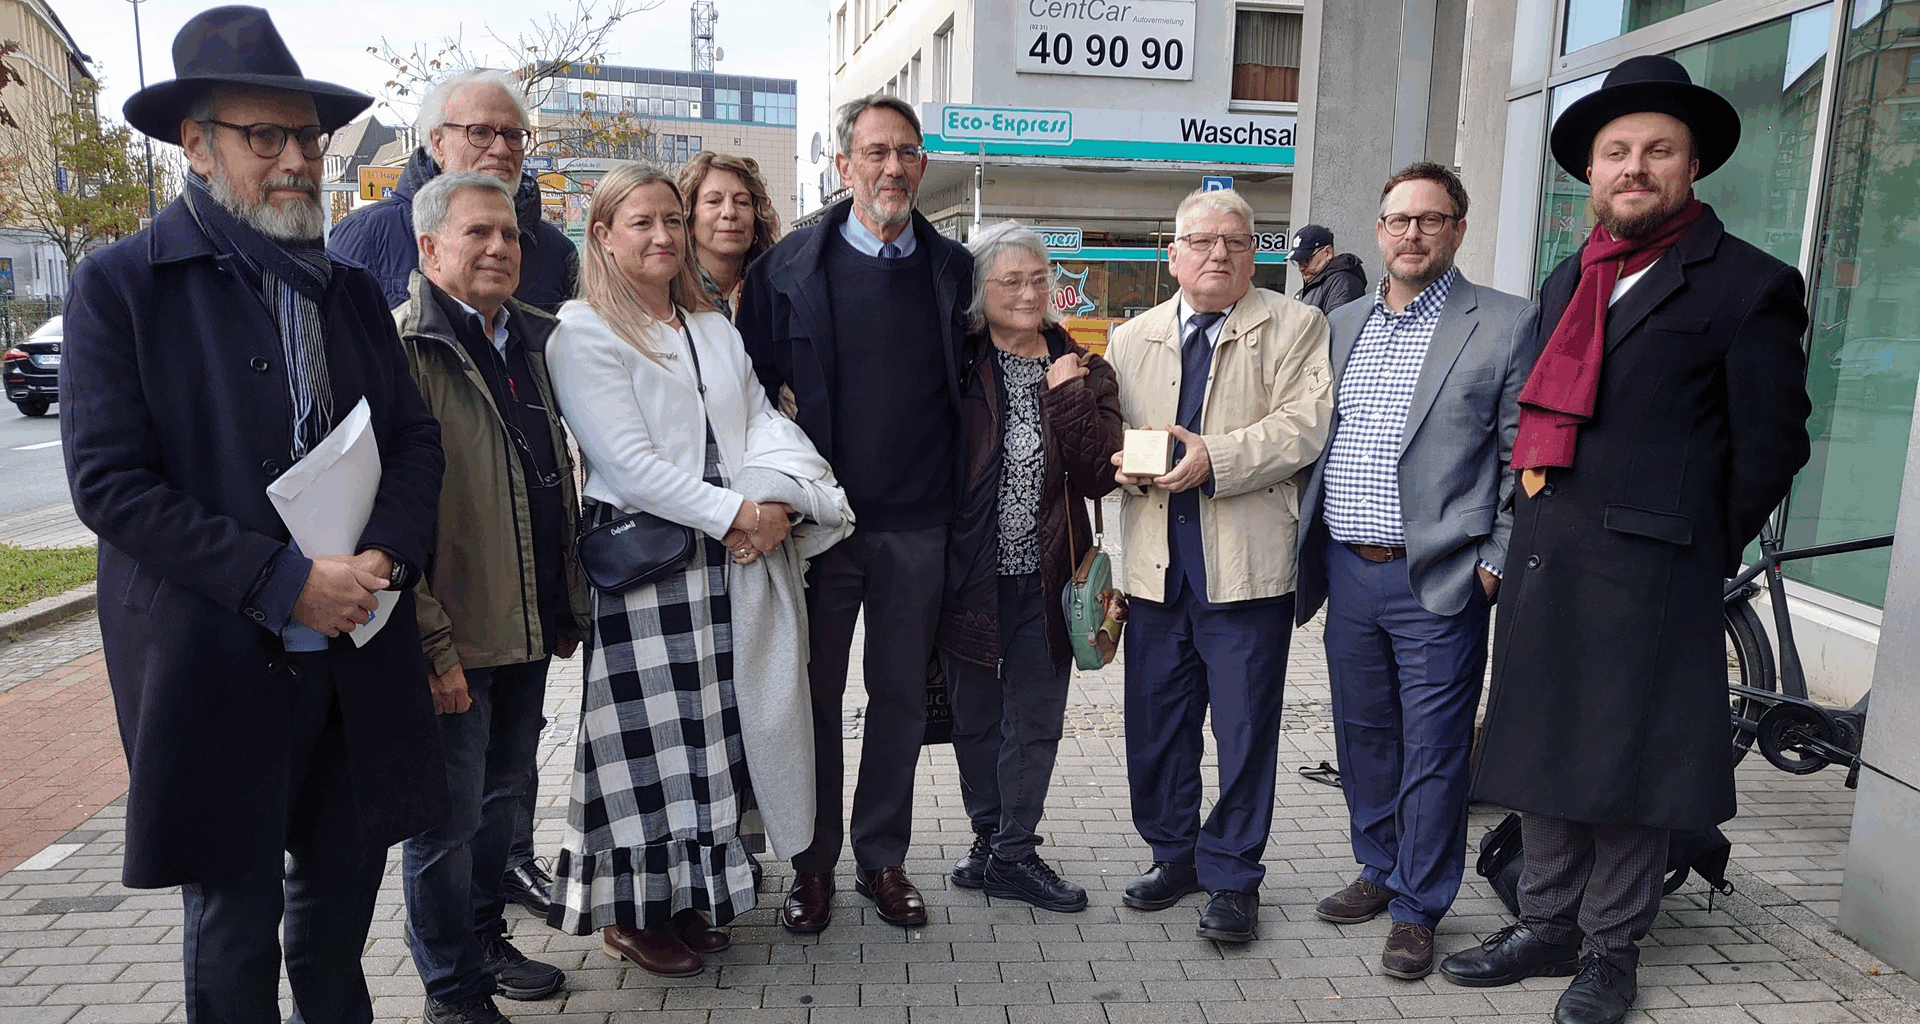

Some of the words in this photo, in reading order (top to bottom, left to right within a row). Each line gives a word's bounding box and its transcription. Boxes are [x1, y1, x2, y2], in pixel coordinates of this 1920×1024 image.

[1029, 0, 1132, 22] CentCar
[1132, 15, 1185, 26] Autovermietung
[1028, 31, 1073, 66] 40
[1086, 33, 1129, 68] 90
[1141, 37, 1184, 71] 90
[948, 111, 1066, 136] Eco-Express
